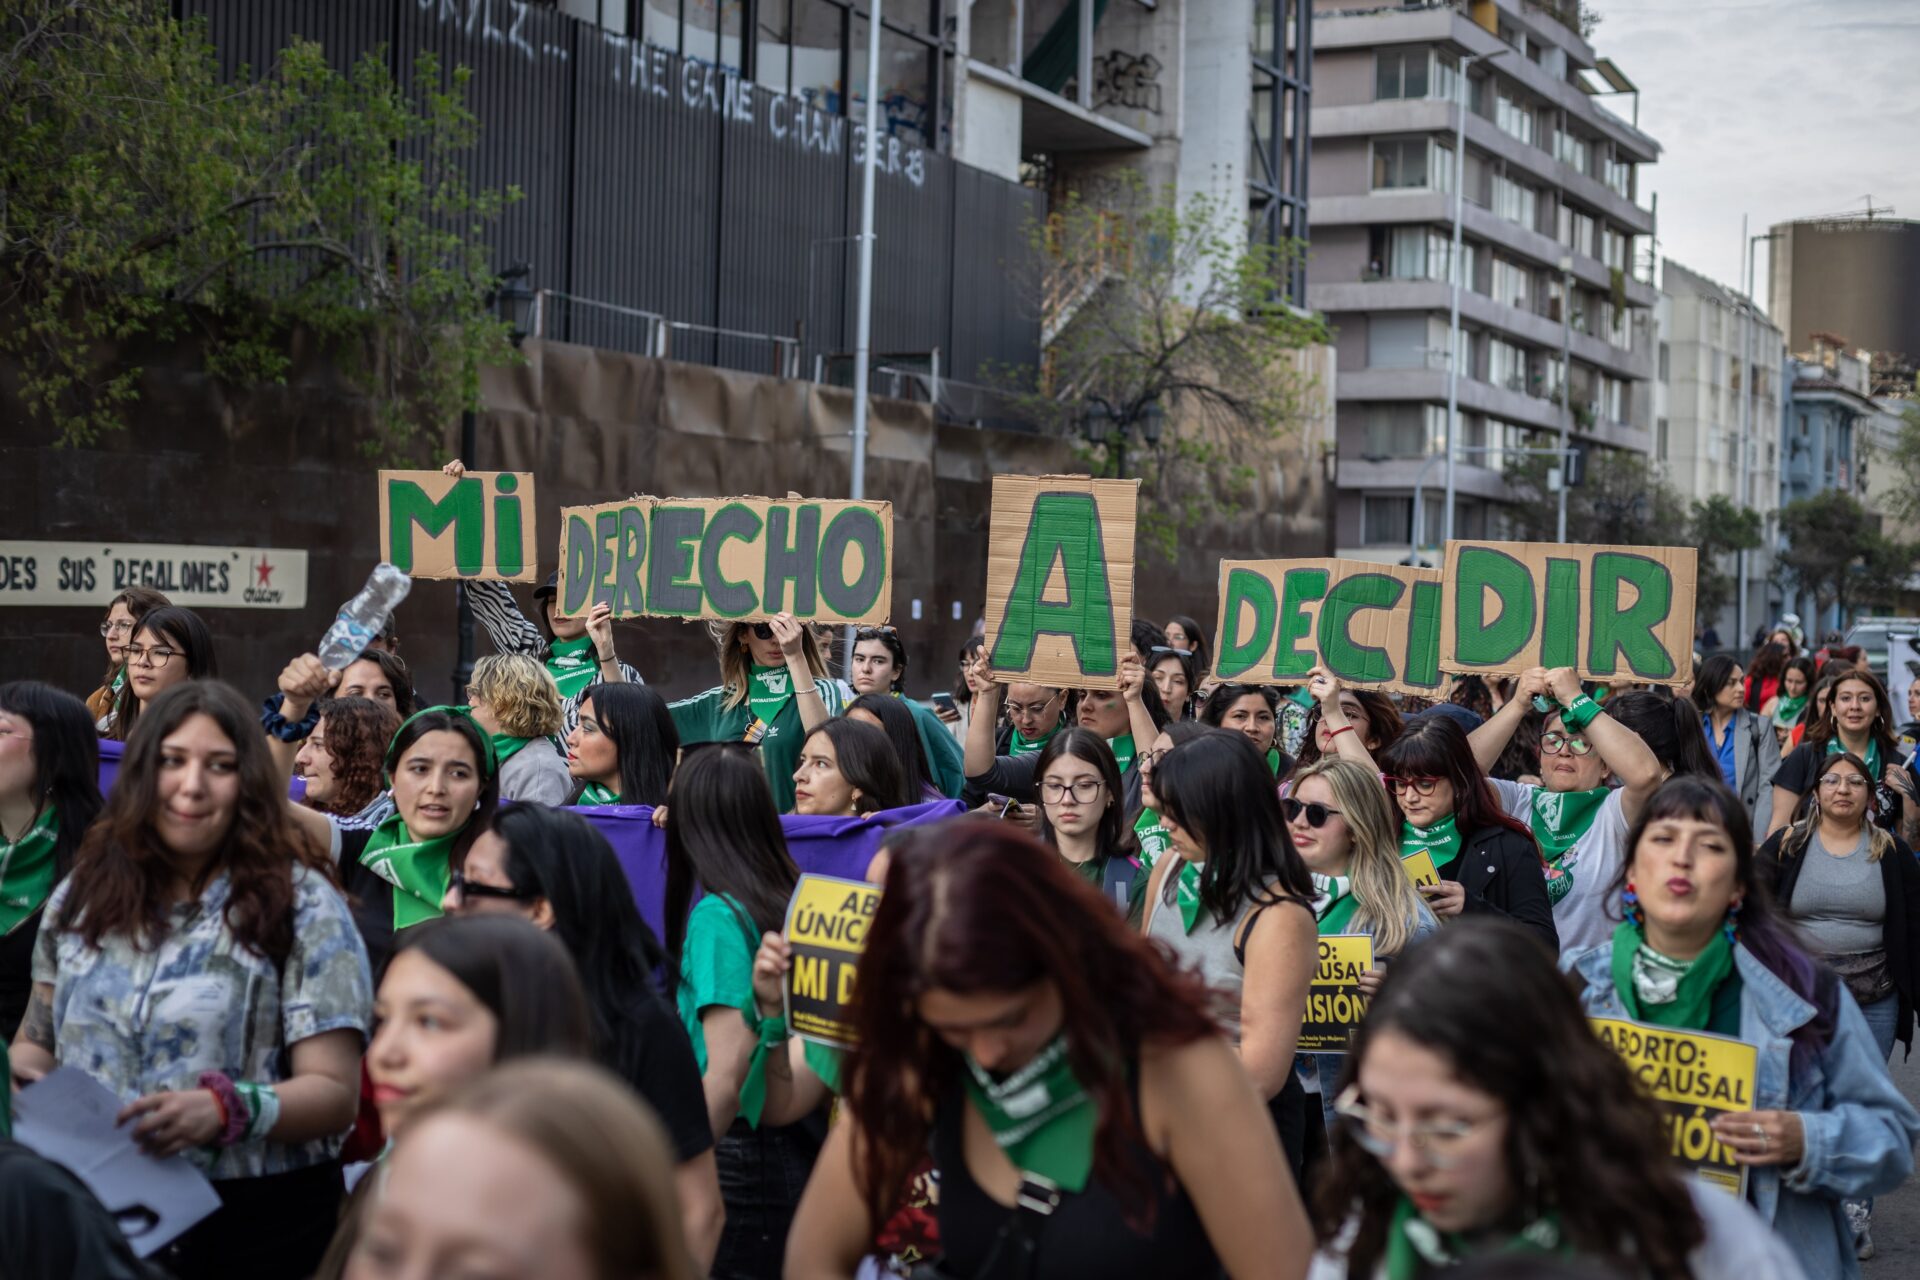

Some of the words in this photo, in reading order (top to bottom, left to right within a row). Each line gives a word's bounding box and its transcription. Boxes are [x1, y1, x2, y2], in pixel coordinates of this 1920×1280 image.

[603, 34, 669, 98] THE
[682, 60, 754, 123] GAME
[58, 556, 96, 591] SUS
[564, 502, 886, 618] DERECHO
[989, 491, 1118, 676] A
[793, 954, 830, 1002] MI
[1598, 1025, 1708, 1068] ABORTO:
[1636, 1063, 1749, 1106] CAUSAL
